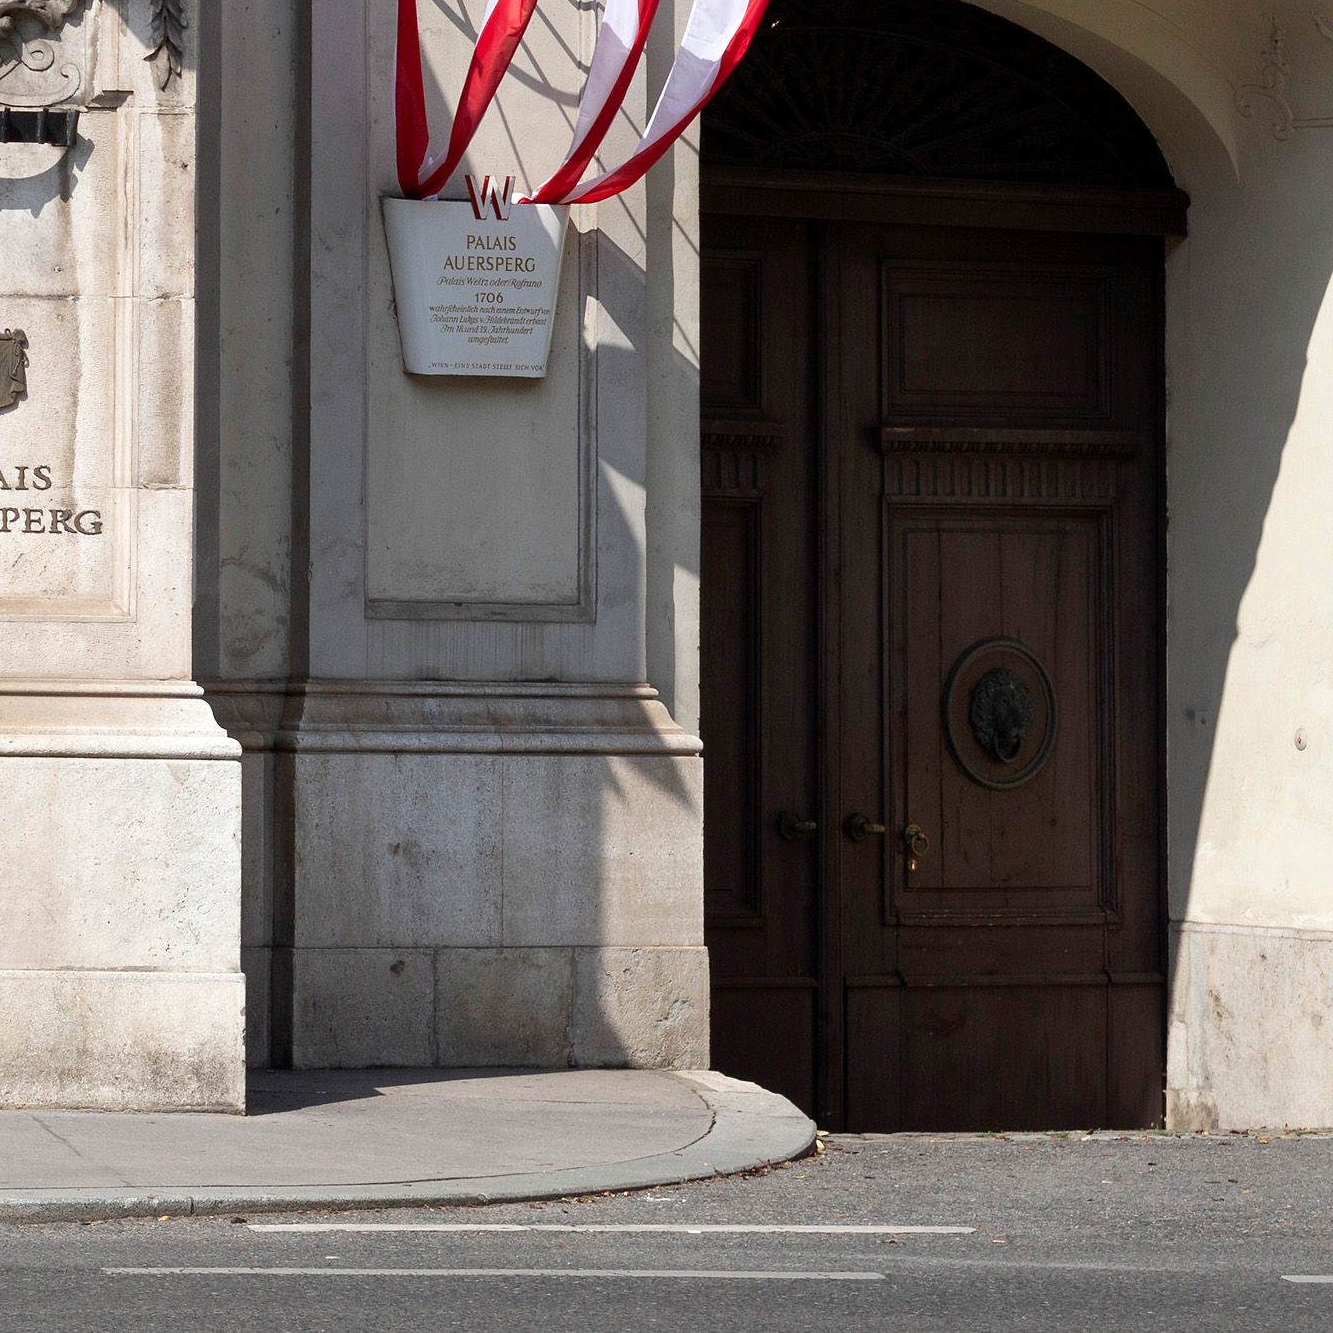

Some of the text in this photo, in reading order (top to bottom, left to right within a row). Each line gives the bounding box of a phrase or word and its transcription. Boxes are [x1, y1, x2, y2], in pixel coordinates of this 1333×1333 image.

[464, 174, 516, 220] W
[466, 234, 517, 251] PALAIS
[443, 255, 536, 273] AUERSPERG
[474, 292, 504, 304] 1706
